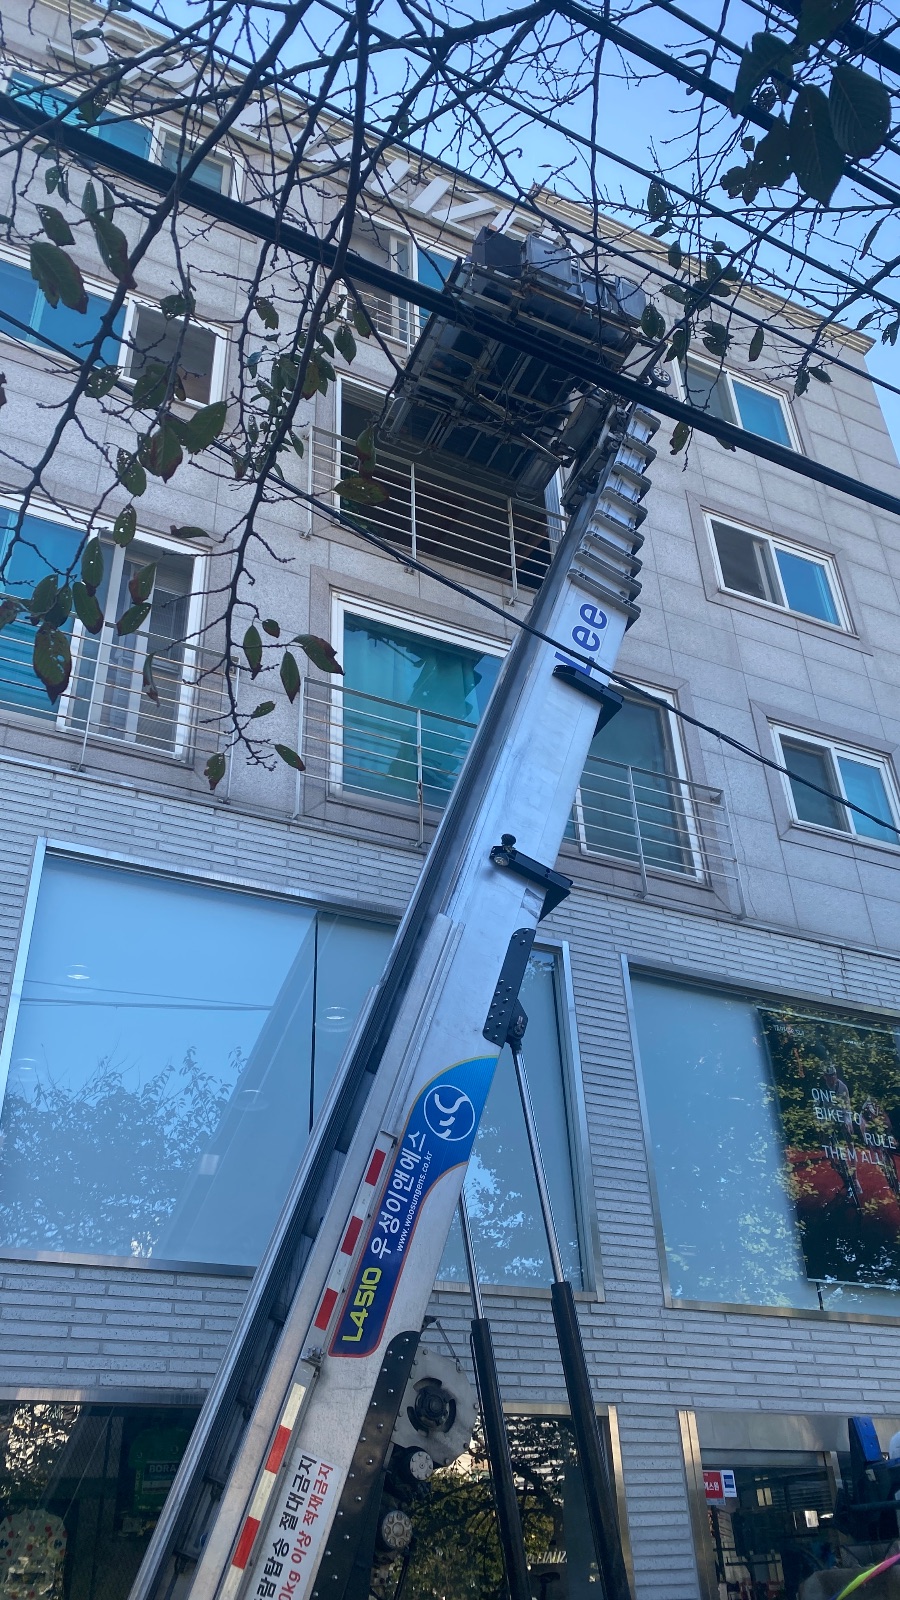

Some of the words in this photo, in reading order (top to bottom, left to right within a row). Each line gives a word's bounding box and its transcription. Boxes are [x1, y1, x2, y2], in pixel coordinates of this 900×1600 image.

[811, 1087, 837, 1104] ONE
[815, 1106, 844, 1124] BIKE
[845, 1111, 862, 1126] TO
[821, 1144, 858, 1163] THEM
[861, 1149, 886, 1166] ALL
[865, 1132, 897, 1150] RULE
[371, 1130, 428, 1260] 우성이앤에스
[395, 1150, 433, 1252] www.woosungens.co.kr
[254, 1537, 290, 1600] 람탑승
[279, 1454, 318, 1531] 절대금지
[290, 1530, 312, 1564] 이상
[303, 1462, 334, 1526] 적재금지
